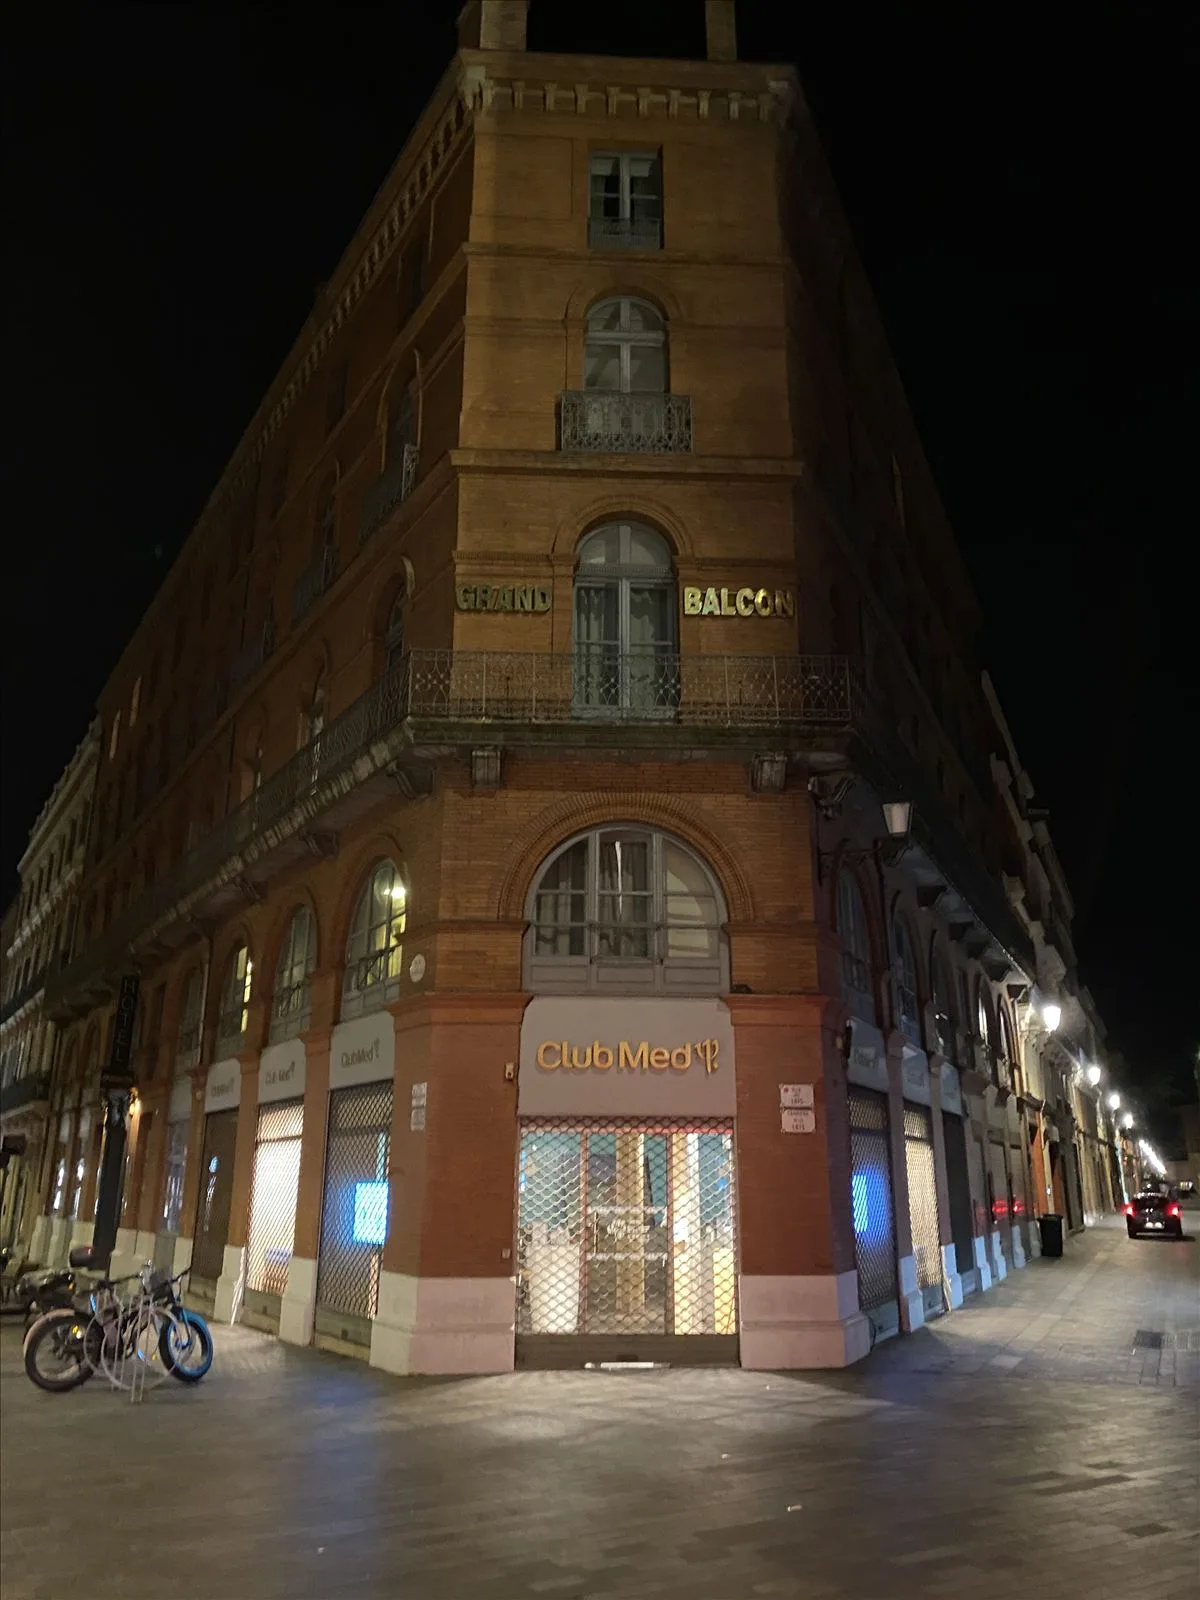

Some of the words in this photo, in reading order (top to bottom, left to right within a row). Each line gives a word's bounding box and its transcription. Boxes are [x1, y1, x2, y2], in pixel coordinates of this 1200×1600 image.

[456, 584, 552, 613] GRAND
[683, 586, 794, 617] BALCON
[115, 978, 139, 1062] HOTEL
[537, 1039, 614, 1070] Club
[618, 1040, 691, 1070] Med
